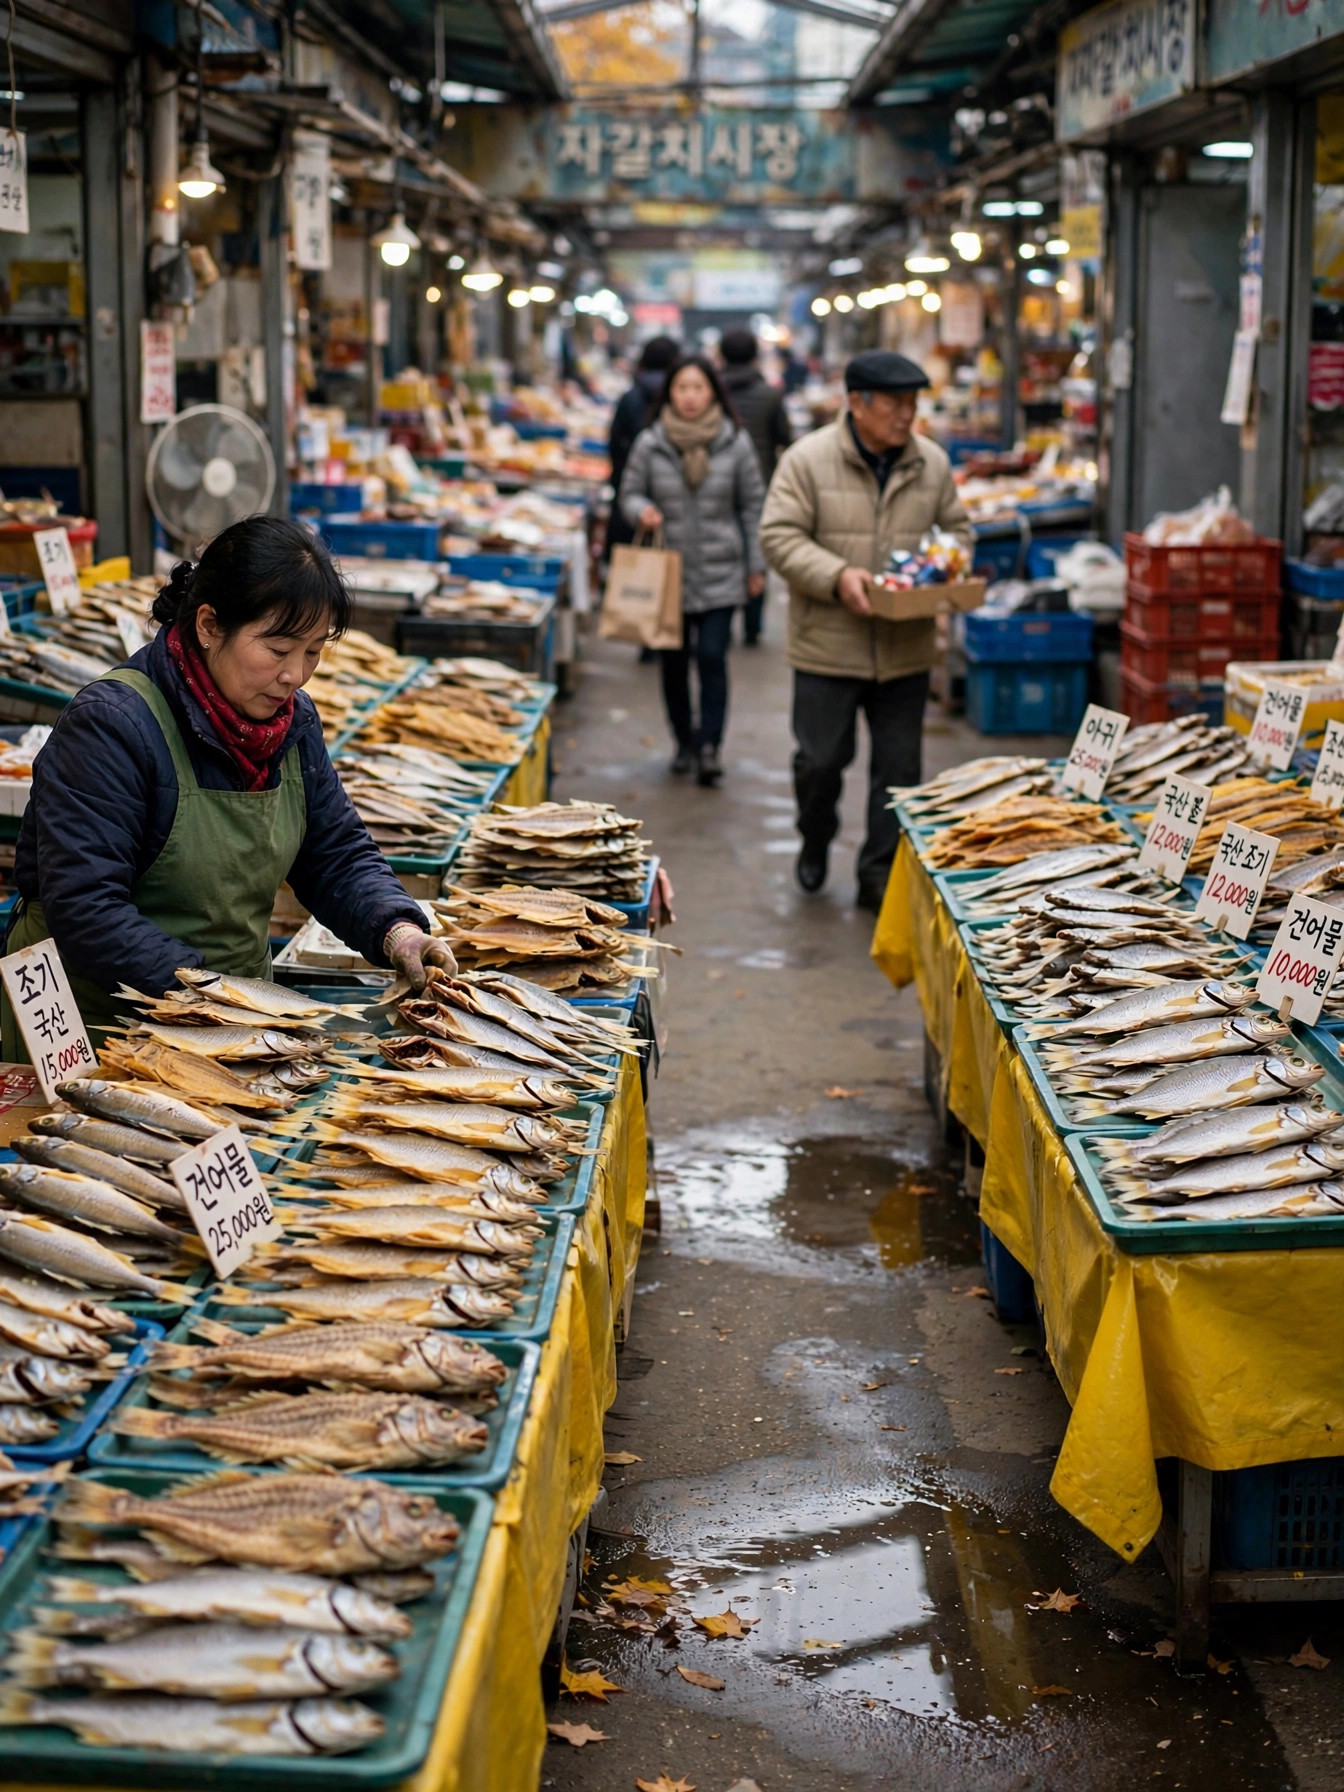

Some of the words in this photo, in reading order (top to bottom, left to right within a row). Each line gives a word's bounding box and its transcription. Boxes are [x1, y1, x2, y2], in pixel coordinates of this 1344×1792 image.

[1086, 717, 1119, 751] 아귀
[1165, 784, 1190, 818] 국산
[1149, 823, 1194, 861] 12,000원
[1221, 833, 1245, 867] 국산
[1241, 844, 1270, 877] 조기
[1206, 872, 1259, 915] 12,000원
[1288, 908, 1343, 957] 건어물
[14, 952, 60, 1005] 조기
[1268, 949, 1331, 997] 10,000원
[33, 1001, 69, 1044] 국산
[40, 1036, 92, 1085] 15,000원
[184, 1142, 254, 1212] 건어물
[208, 1192, 275, 1257] 25,000원
